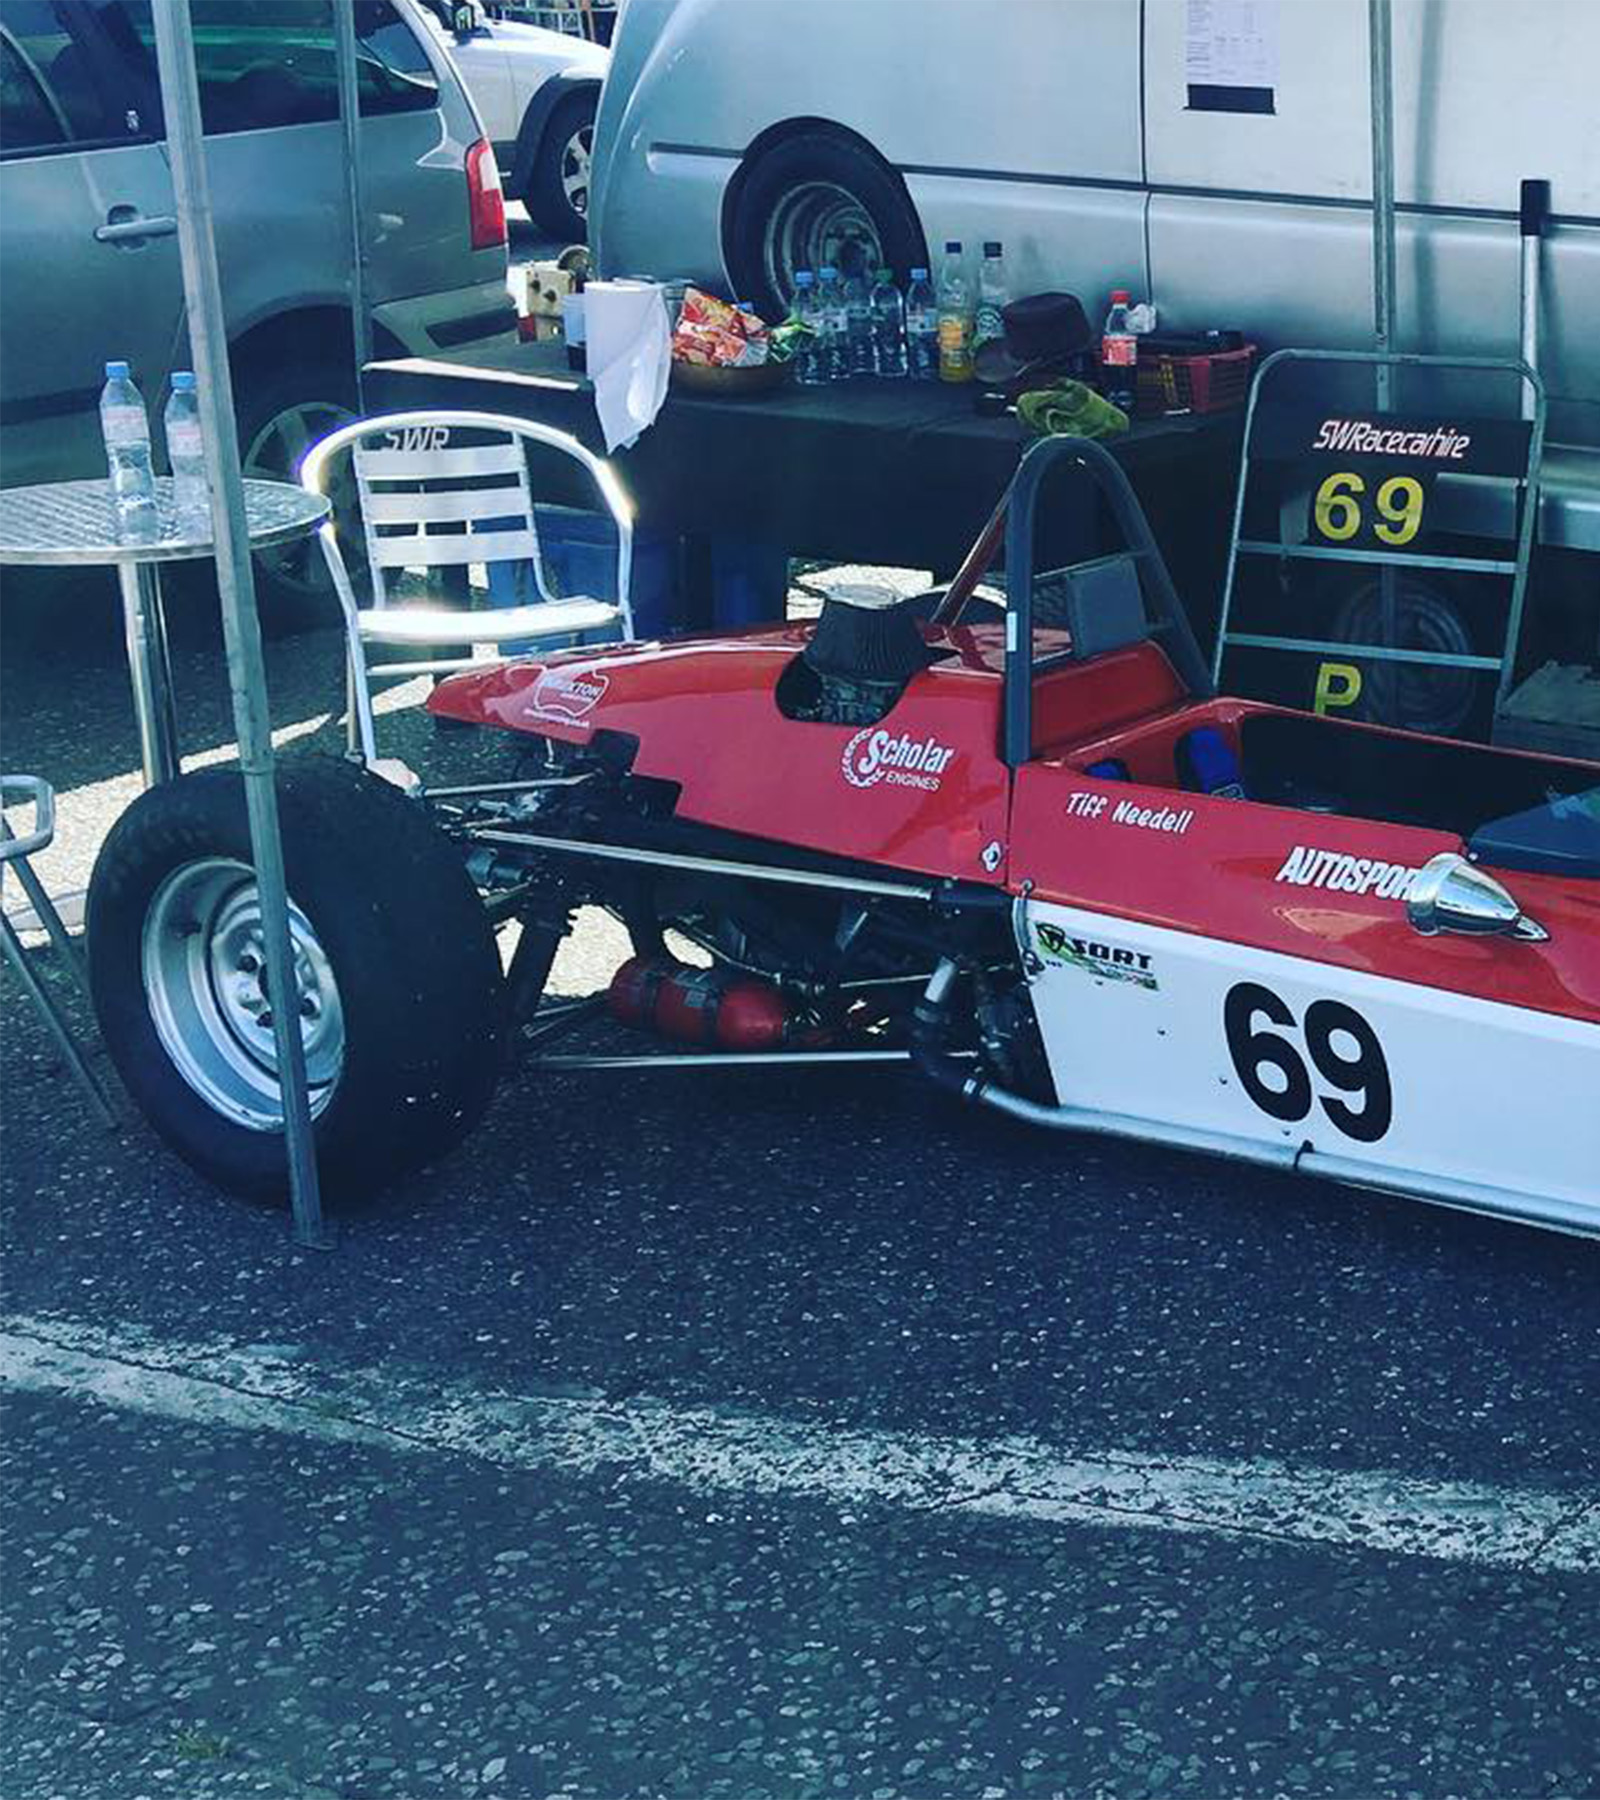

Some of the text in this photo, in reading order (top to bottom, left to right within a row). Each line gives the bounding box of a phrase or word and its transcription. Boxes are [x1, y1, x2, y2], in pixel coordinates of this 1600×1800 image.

[1312, 419, 1471, 459] SWRacecarhire
[1314, 471, 1424, 545] 69
[1315, 662, 1361, 714] P
[858, 730, 955, 774] Scholar
[885, 769, 941, 791] ENGINES
[1066, 793, 1194, 833] Tiff Needell
[1275, 846, 1420, 902] AUTOSPOR
[1223, 981, 1393, 1144] 69
